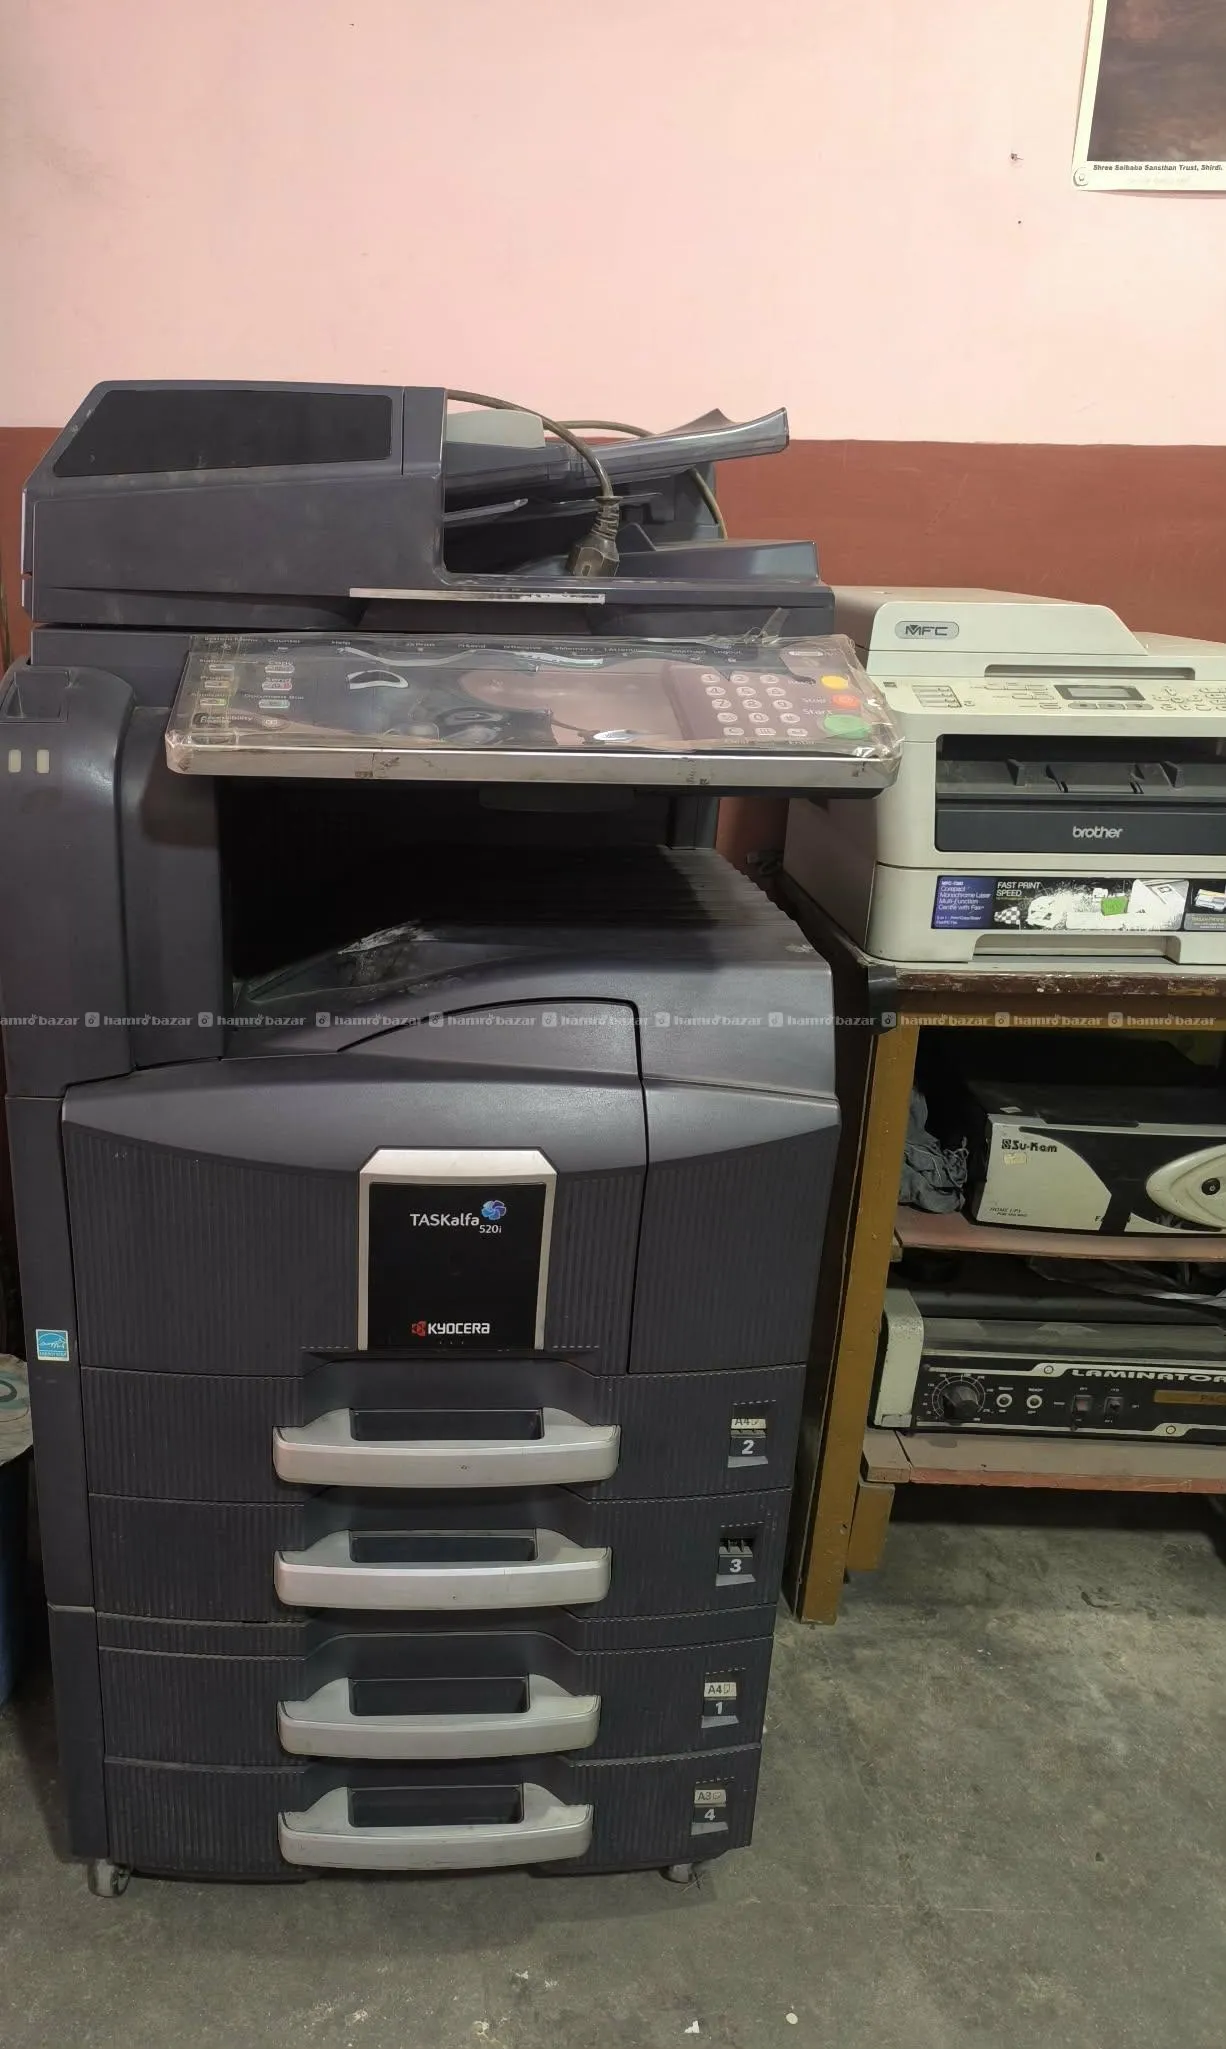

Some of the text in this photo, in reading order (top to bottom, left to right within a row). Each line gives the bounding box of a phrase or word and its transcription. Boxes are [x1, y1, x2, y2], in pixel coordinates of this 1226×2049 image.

[1178, 164, 1199, 172] Trust,
[905, 624, 948, 636] MFC
[1073, 827, 1123, 838] brother
[996, 889, 1022, 897] SPEED
[1012, 1139, 1058, 1152] Su-Kam
[410, 1213, 479, 1227] TASKalfa
[479, 1224, 502, 1234] 520i
[428, 1323, 490, 1335] KYOCERA
[734, 1418, 749, 1426] A4
[741, 1439, 755, 1454] 2
[729, 1558, 742, 1573] 3
[708, 1684, 723, 1694] A4
[715, 1701, 724, 1715] 1
[697, 1791, 712, 1800] A3
[704, 1808, 716, 1821] 4
